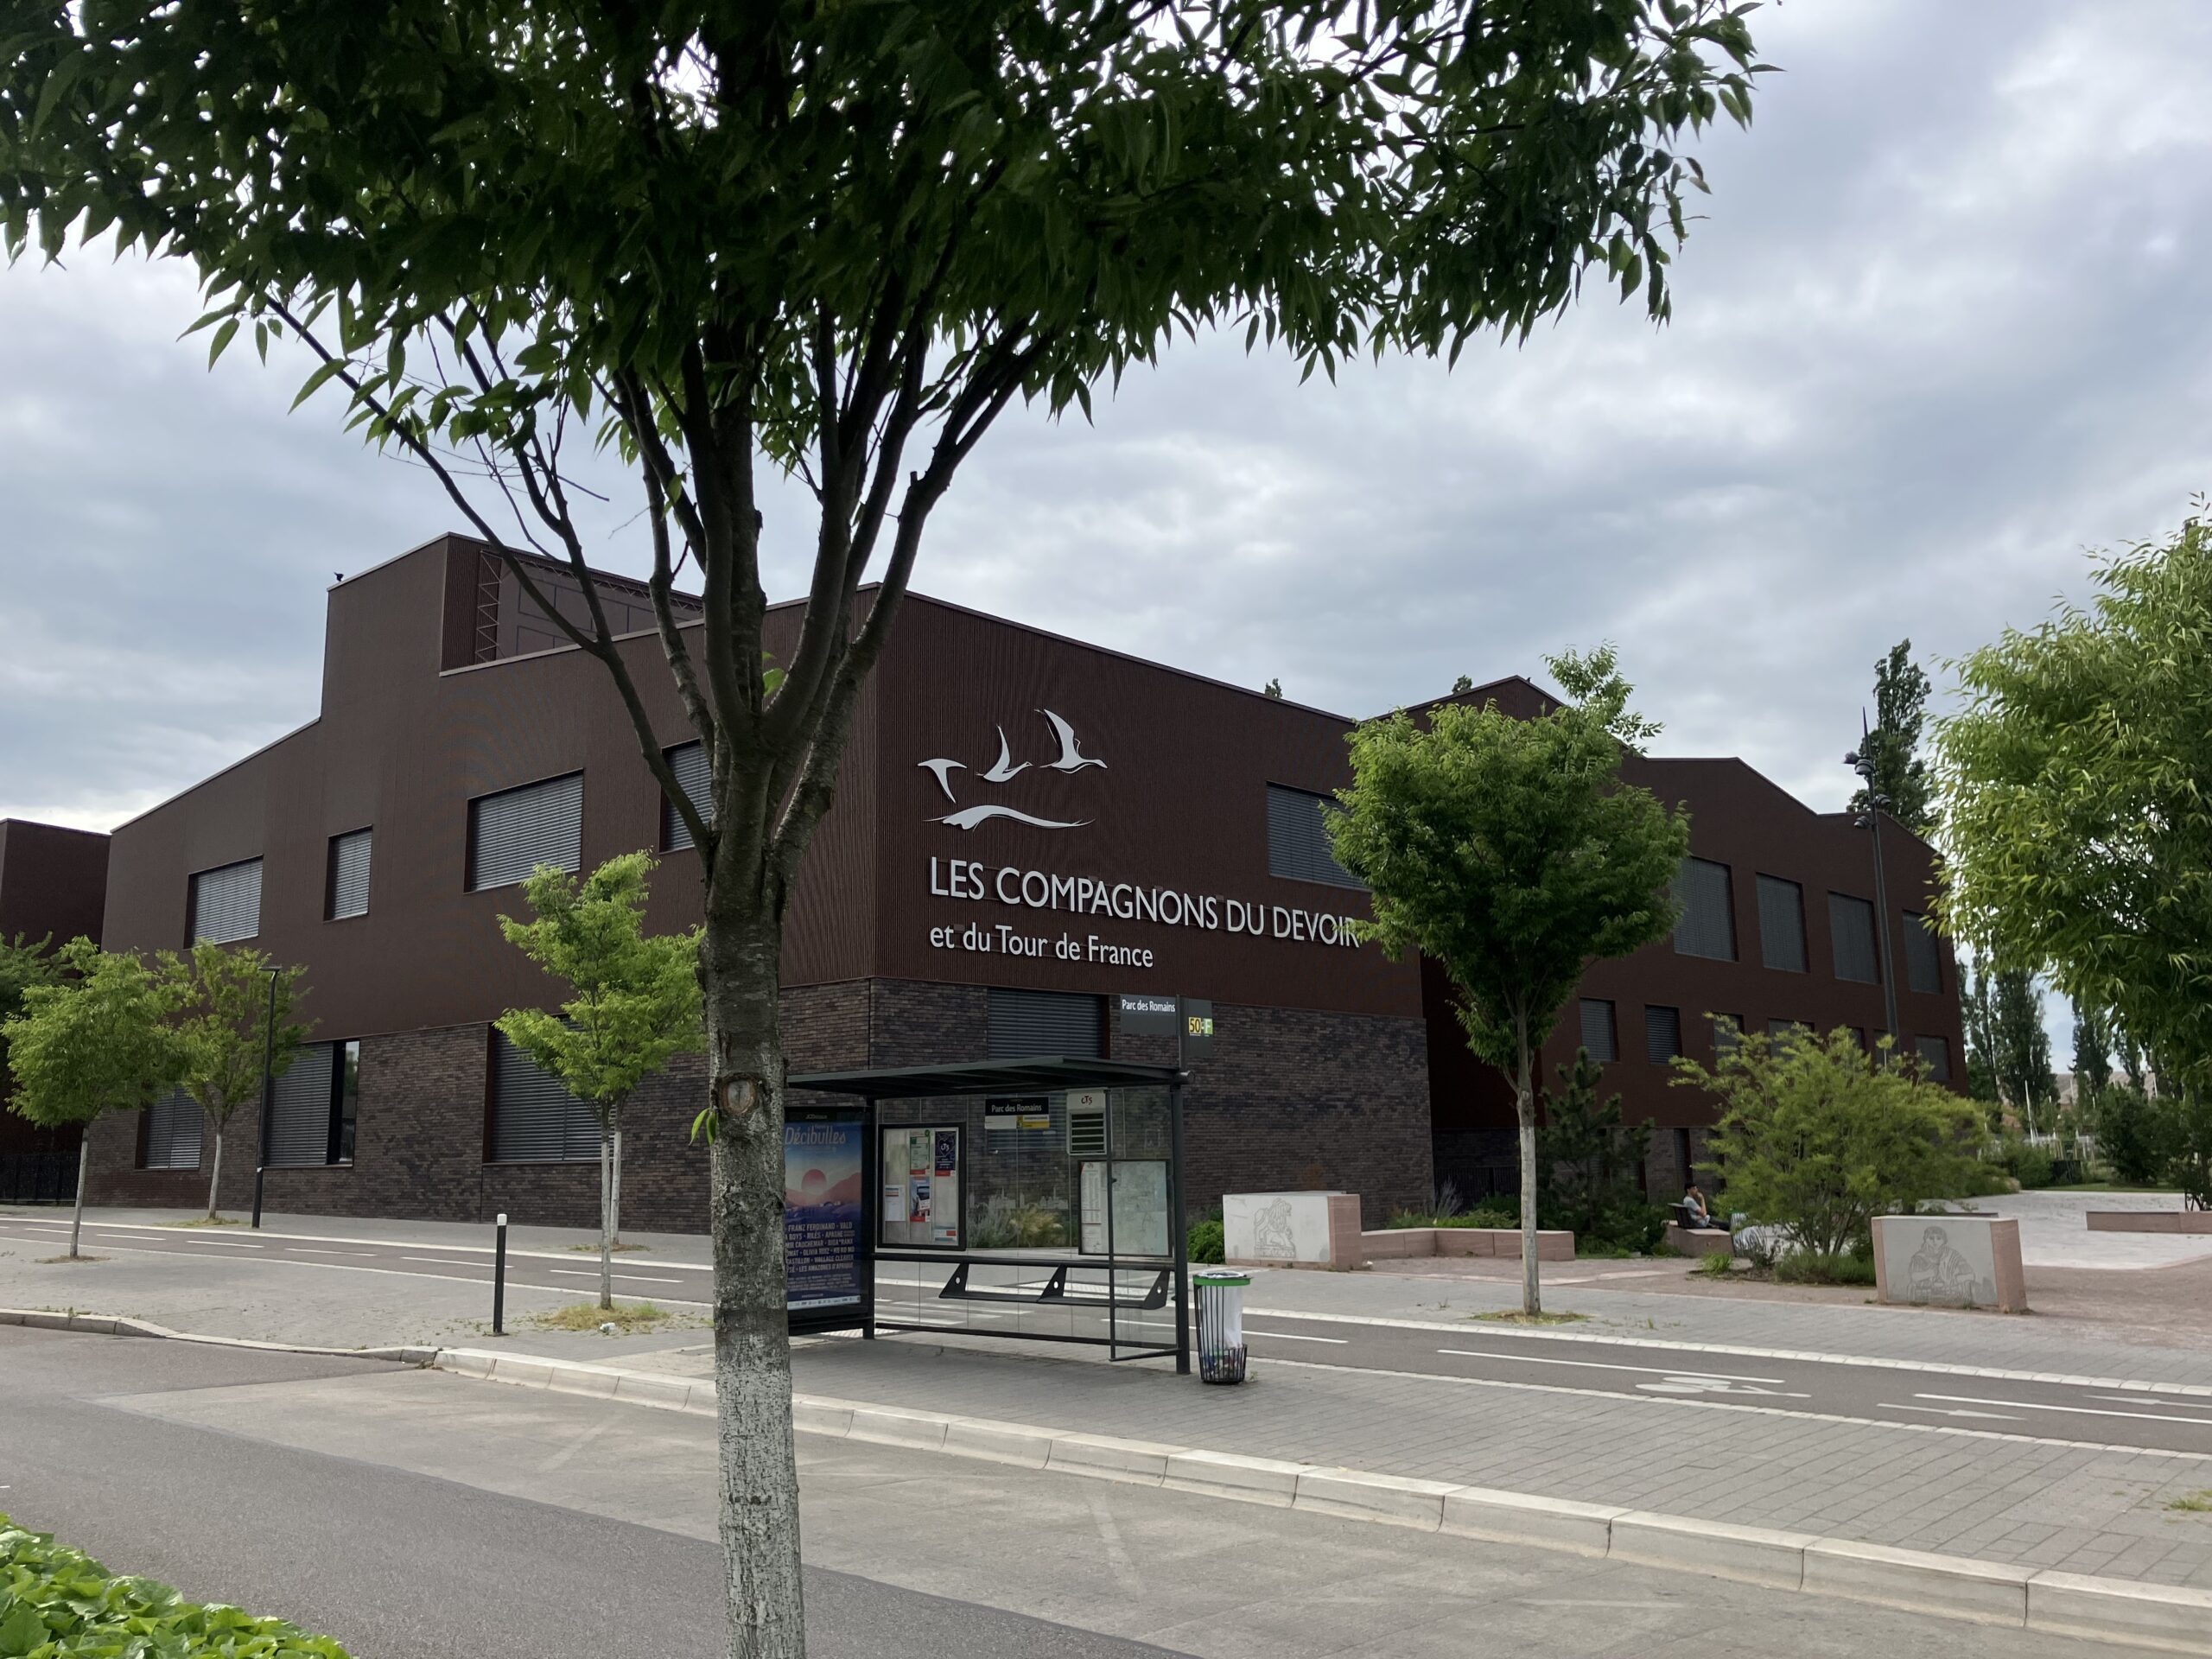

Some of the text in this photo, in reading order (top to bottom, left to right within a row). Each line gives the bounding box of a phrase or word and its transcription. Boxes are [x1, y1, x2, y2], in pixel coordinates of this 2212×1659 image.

[931, 856, 1360, 949] LES COMPAGNONS DU DEVOIR
[930, 922, 1154, 969] et du Tour de France
[1122, 999, 1176, 1013] Parc des Romains
[1189, 1018, 1201, 1033] 50
[991, 1103, 1042, 1113] Parc des Romains
[785, 1124, 847, 1146] Décibulles
[806, 1223, 835, 1231] FERDINAND
